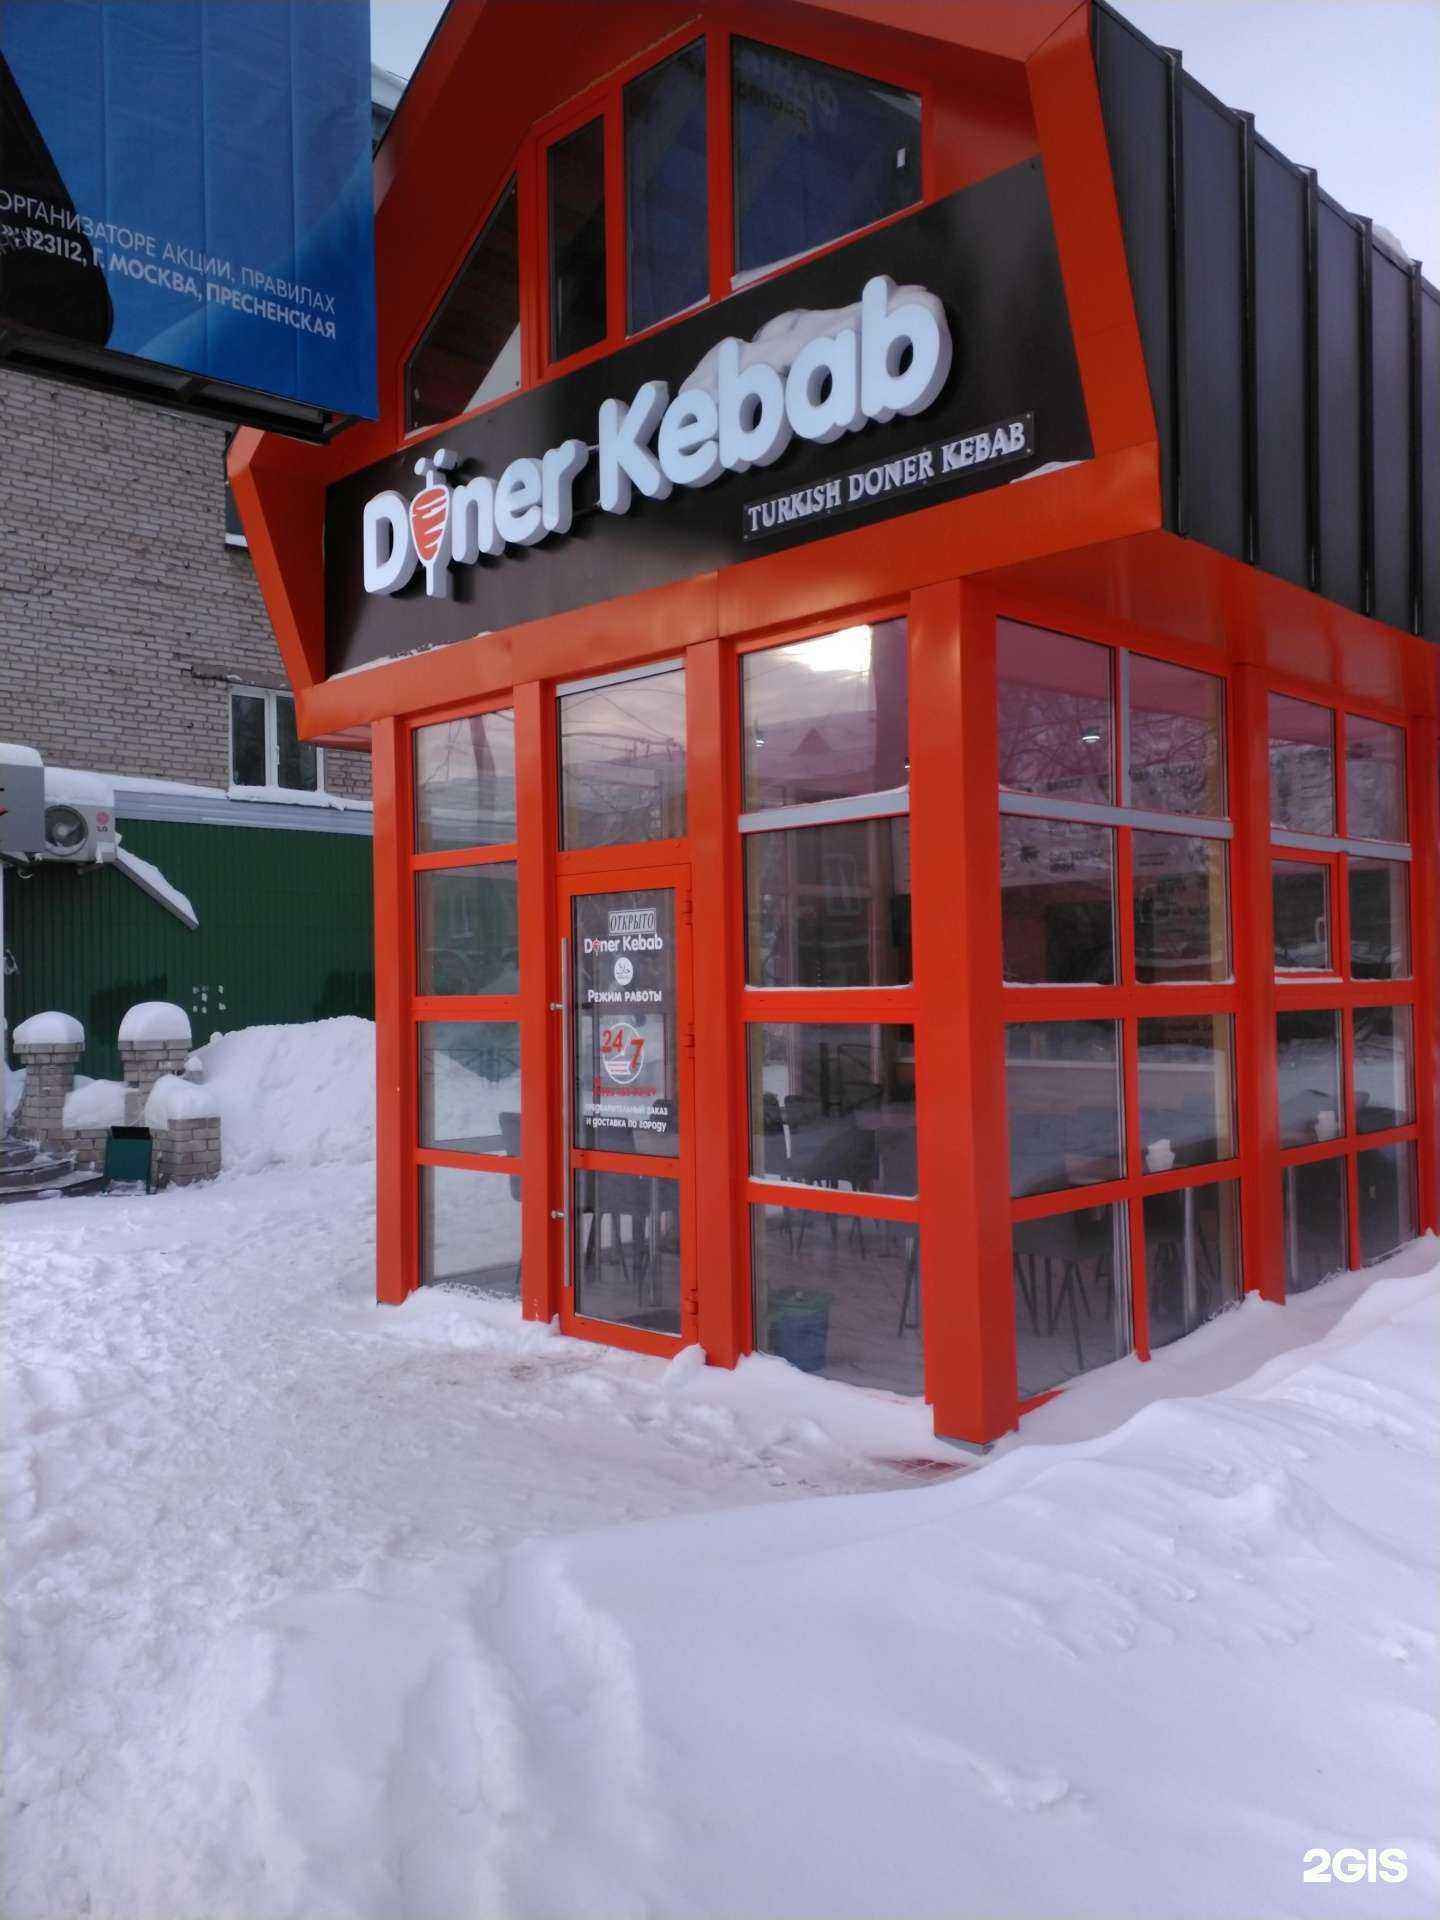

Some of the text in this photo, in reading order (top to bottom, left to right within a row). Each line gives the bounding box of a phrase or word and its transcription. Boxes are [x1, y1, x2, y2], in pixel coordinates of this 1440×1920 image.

[0, 190, 336, 314] ОРГАНИЗАТОРЕ АКЦИИ, ПРАВИЛАХ
[109, 252, 202, 301] МОСКВА,
[206, 282, 337, 340] ПРЕСНЕНСКАЯ
[598, 274, 952, 515] Kebab
[748, 421, 1026, 532] TURKISH DONER KEBAB
[609, 911, 655, 931] ОТКРЫТО
[623, 932, 663, 951] Kebab
[600, 1028, 646, 1070] 24 7
